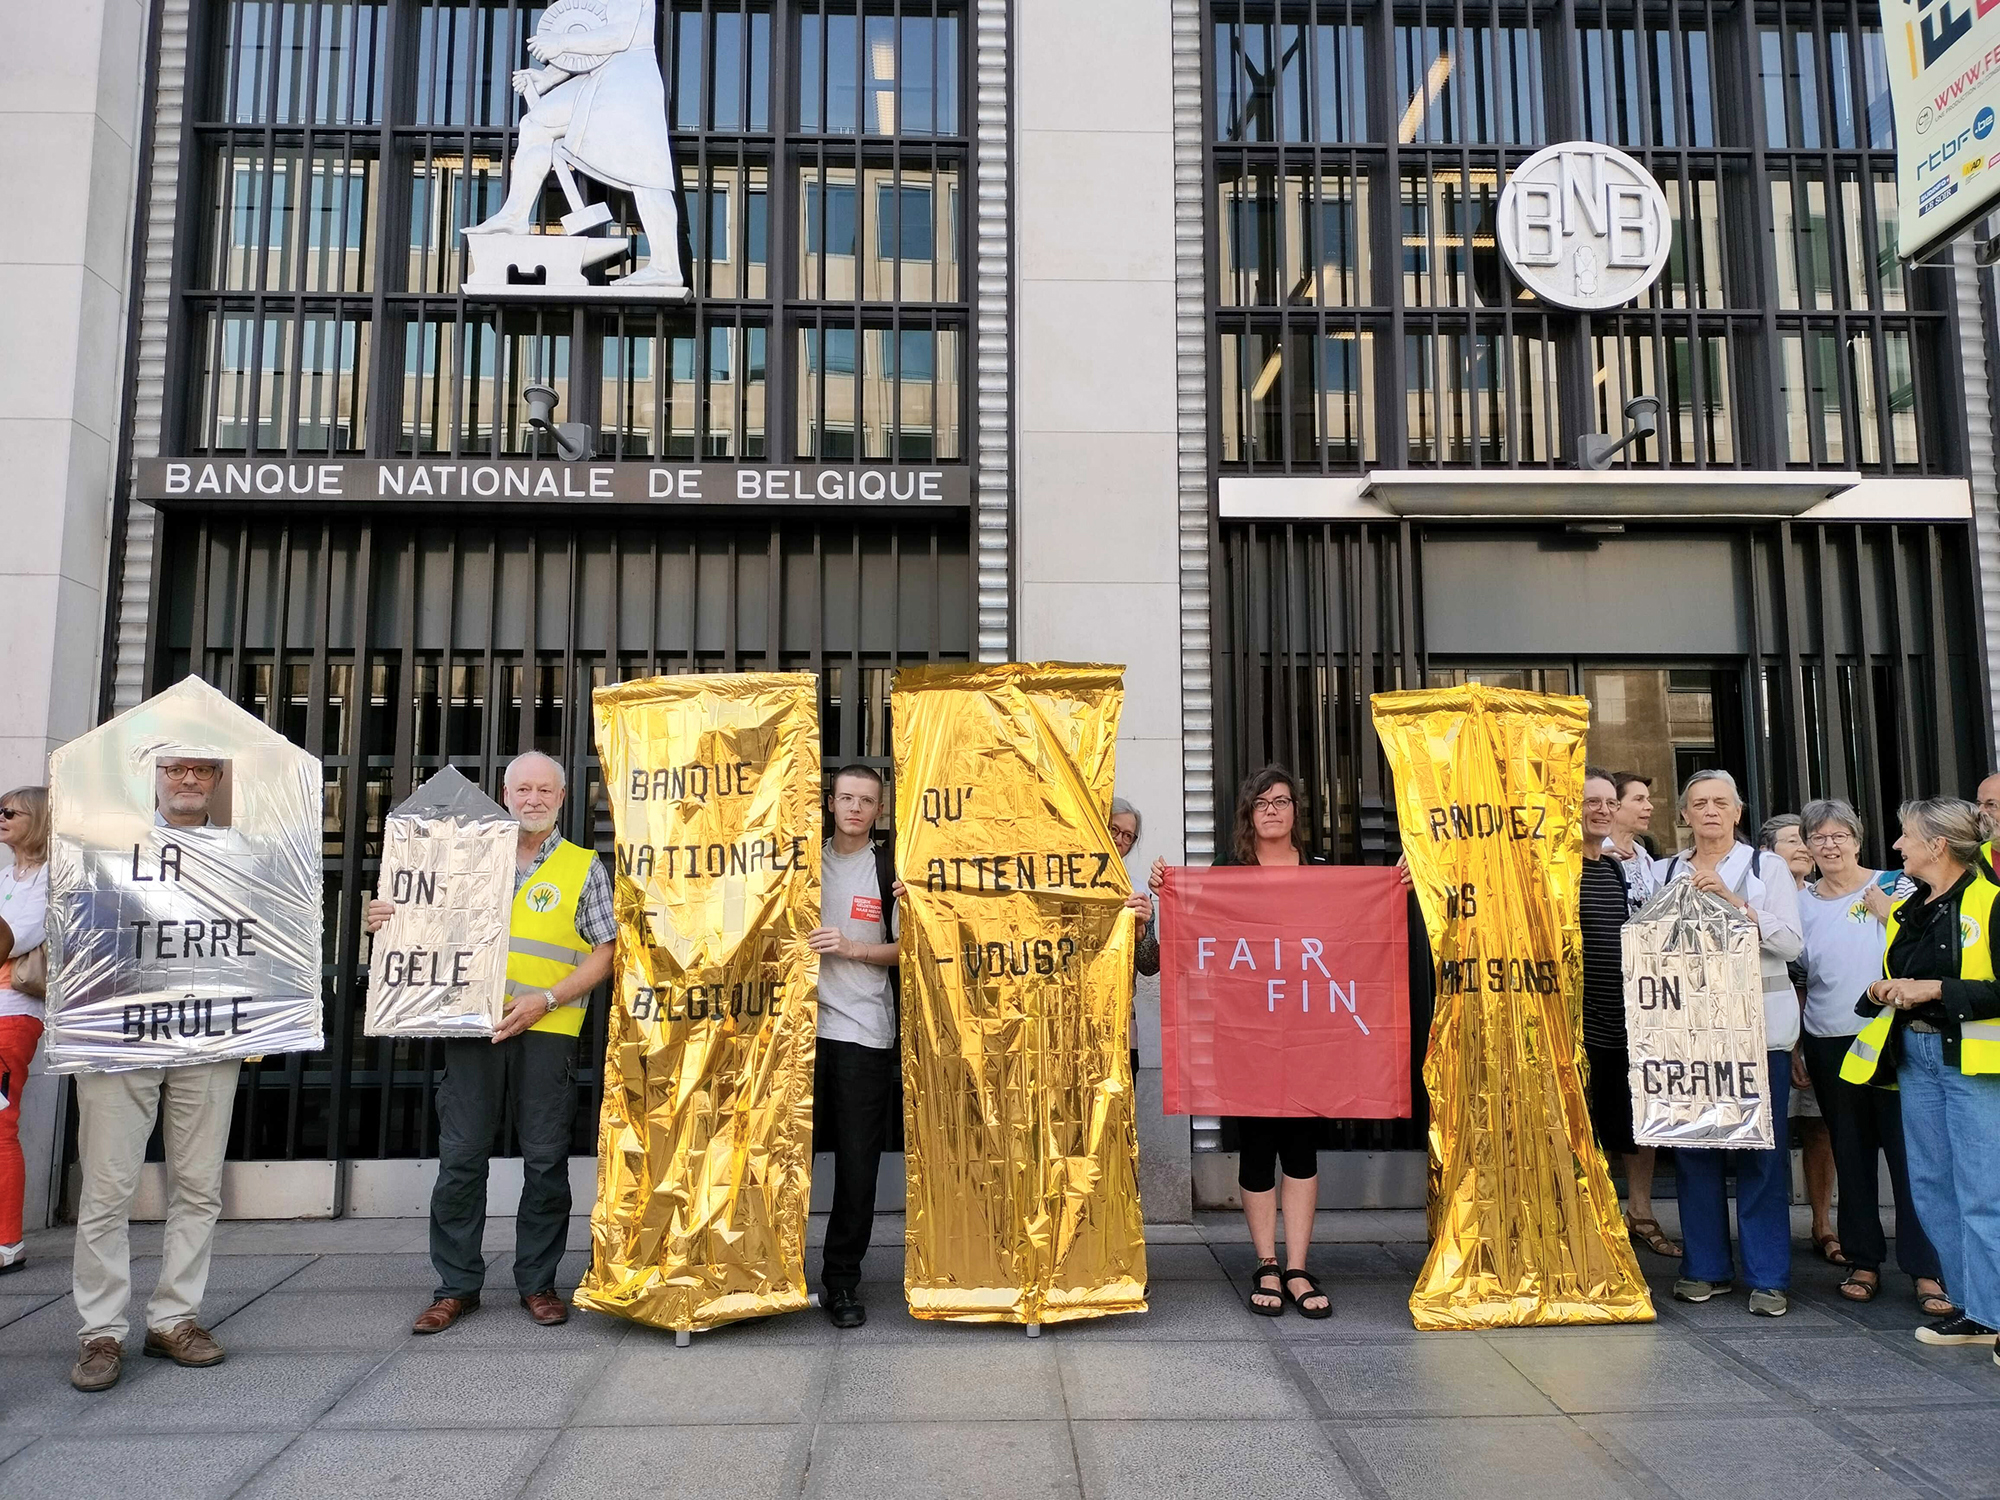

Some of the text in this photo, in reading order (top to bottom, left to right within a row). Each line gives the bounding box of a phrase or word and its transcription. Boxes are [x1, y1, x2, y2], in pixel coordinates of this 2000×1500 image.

[1512, 151, 1654, 269] BNB
[165, 463, 943, 501] BANQUE NATIONALE DE BELGIQUE
[631, 761, 754, 803] BANQUE
[923, 787, 974, 828] QU'
[132, 843, 181, 882] LA
[616, 836, 809, 879] NATIONALE
[393, 869, 436, 905] ON
[130, 918, 258, 960] TERRE
[1197, 937, 1332, 978] FAIR
[384, 945, 474, 988] GÈLE
[631, 981, 787, 1022] BELGIQUE
[1267, 980, 1370, 1036] FIN
[1638, 976, 1682, 1011] ON
[122, 993, 253, 1043] BRÛLE
